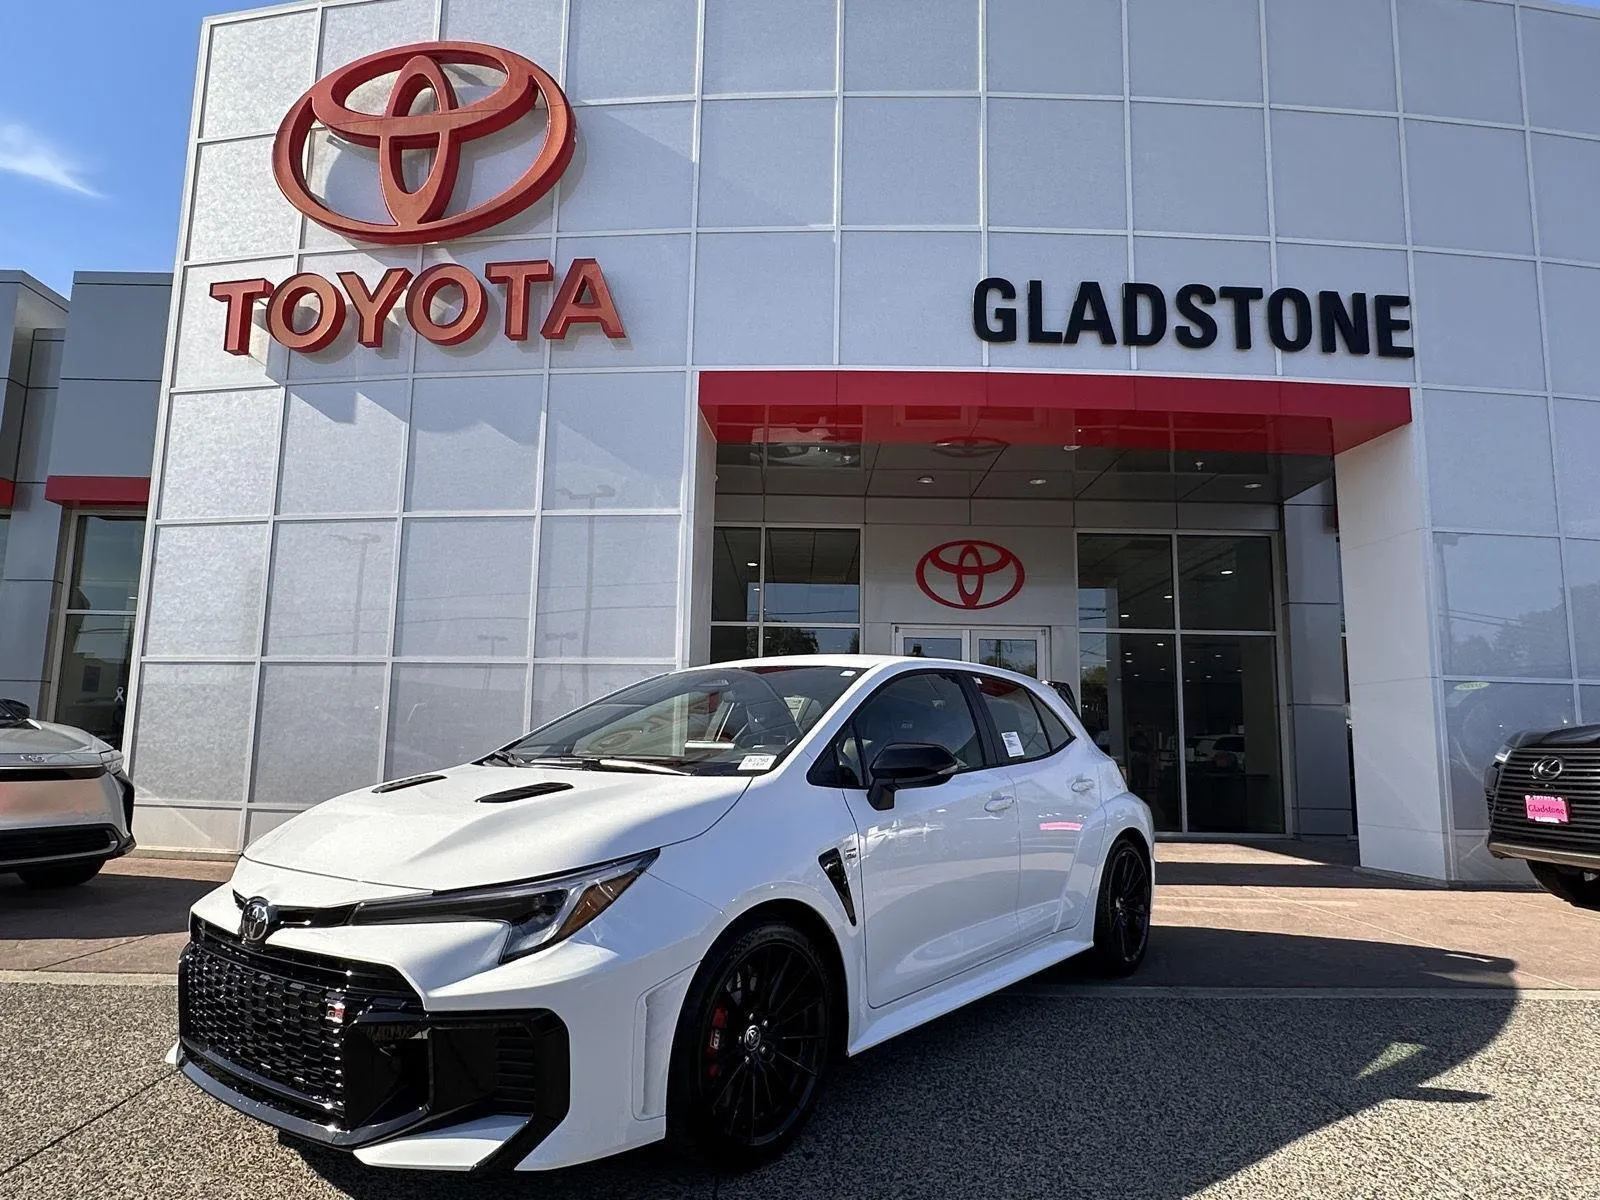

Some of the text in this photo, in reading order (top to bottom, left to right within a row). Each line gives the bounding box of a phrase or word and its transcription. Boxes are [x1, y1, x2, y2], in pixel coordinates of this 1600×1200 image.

[209, 257, 627, 356] TOYOTA
[972, 276, 1415, 359] GLADSTONE
[1527, 804, 1565, 815] Gladstone
